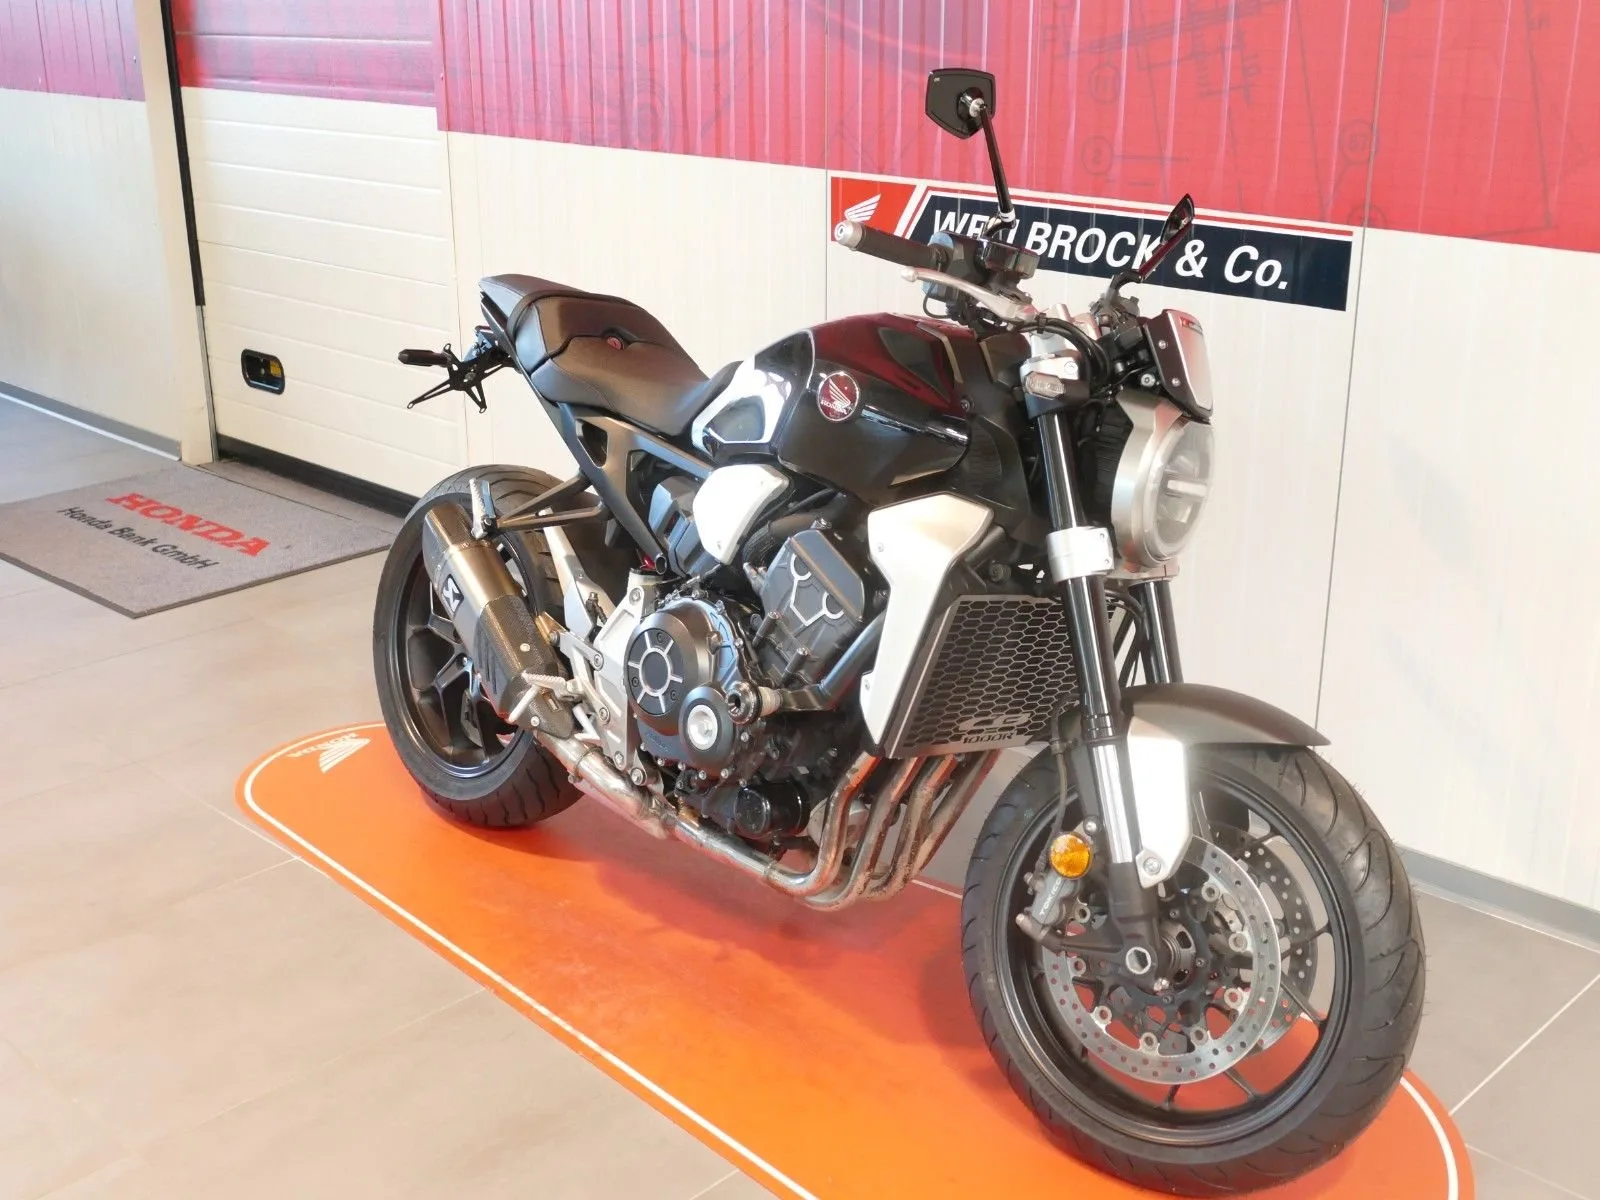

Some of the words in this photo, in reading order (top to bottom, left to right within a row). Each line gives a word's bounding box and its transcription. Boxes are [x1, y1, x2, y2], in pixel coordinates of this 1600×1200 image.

[933, 209, 1163, 273] WEBROCK
[1174, 239, 1208, 278] &
[1223, 245, 1288, 290] Co.
[57, 506, 113, 531] Honda
[107, 526, 158, 548] Bank
[151, 543, 220, 570] GmbH
[105, 492, 270, 557] HONDA
